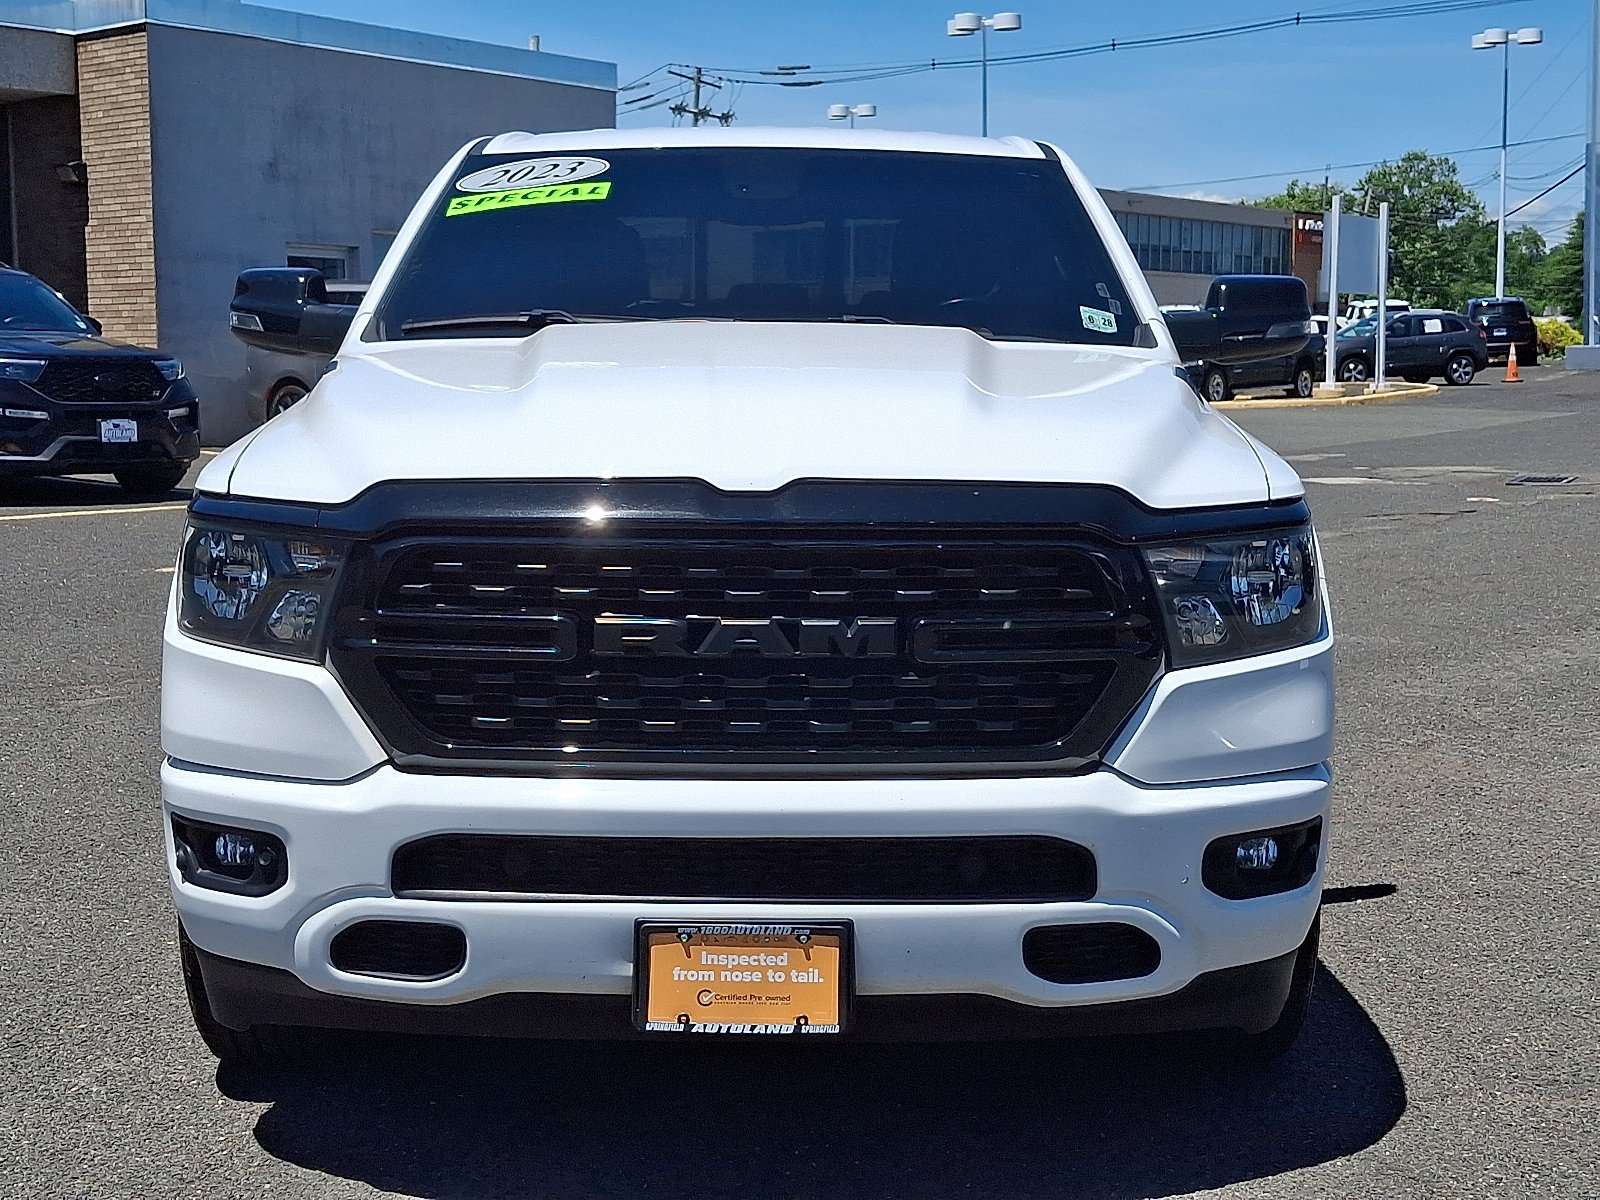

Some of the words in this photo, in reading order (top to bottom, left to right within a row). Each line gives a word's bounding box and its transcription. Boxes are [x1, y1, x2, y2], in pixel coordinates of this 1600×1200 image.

[480, 161, 585, 188] 2023
[452, 186, 602, 210] SPECIAL
[594, 613, 898, 657] RAM
[701, 951, 788, 968] Inspected
[672, 967, 715, 981] from
[720, 970, 763, 982] nose
[766, 969, 786, 982] to
[790, 968, 824, 983] tail.
[714, 993, 747, 1001] Certified
[749, 994, 763, 1002] Pre
[646, 1022, 684, 1031] SPRINGFIELD
[691, 1023, 795, 1034] AUTOLAND
[801, 1025, 840, 1033] SPRINGFIELD
